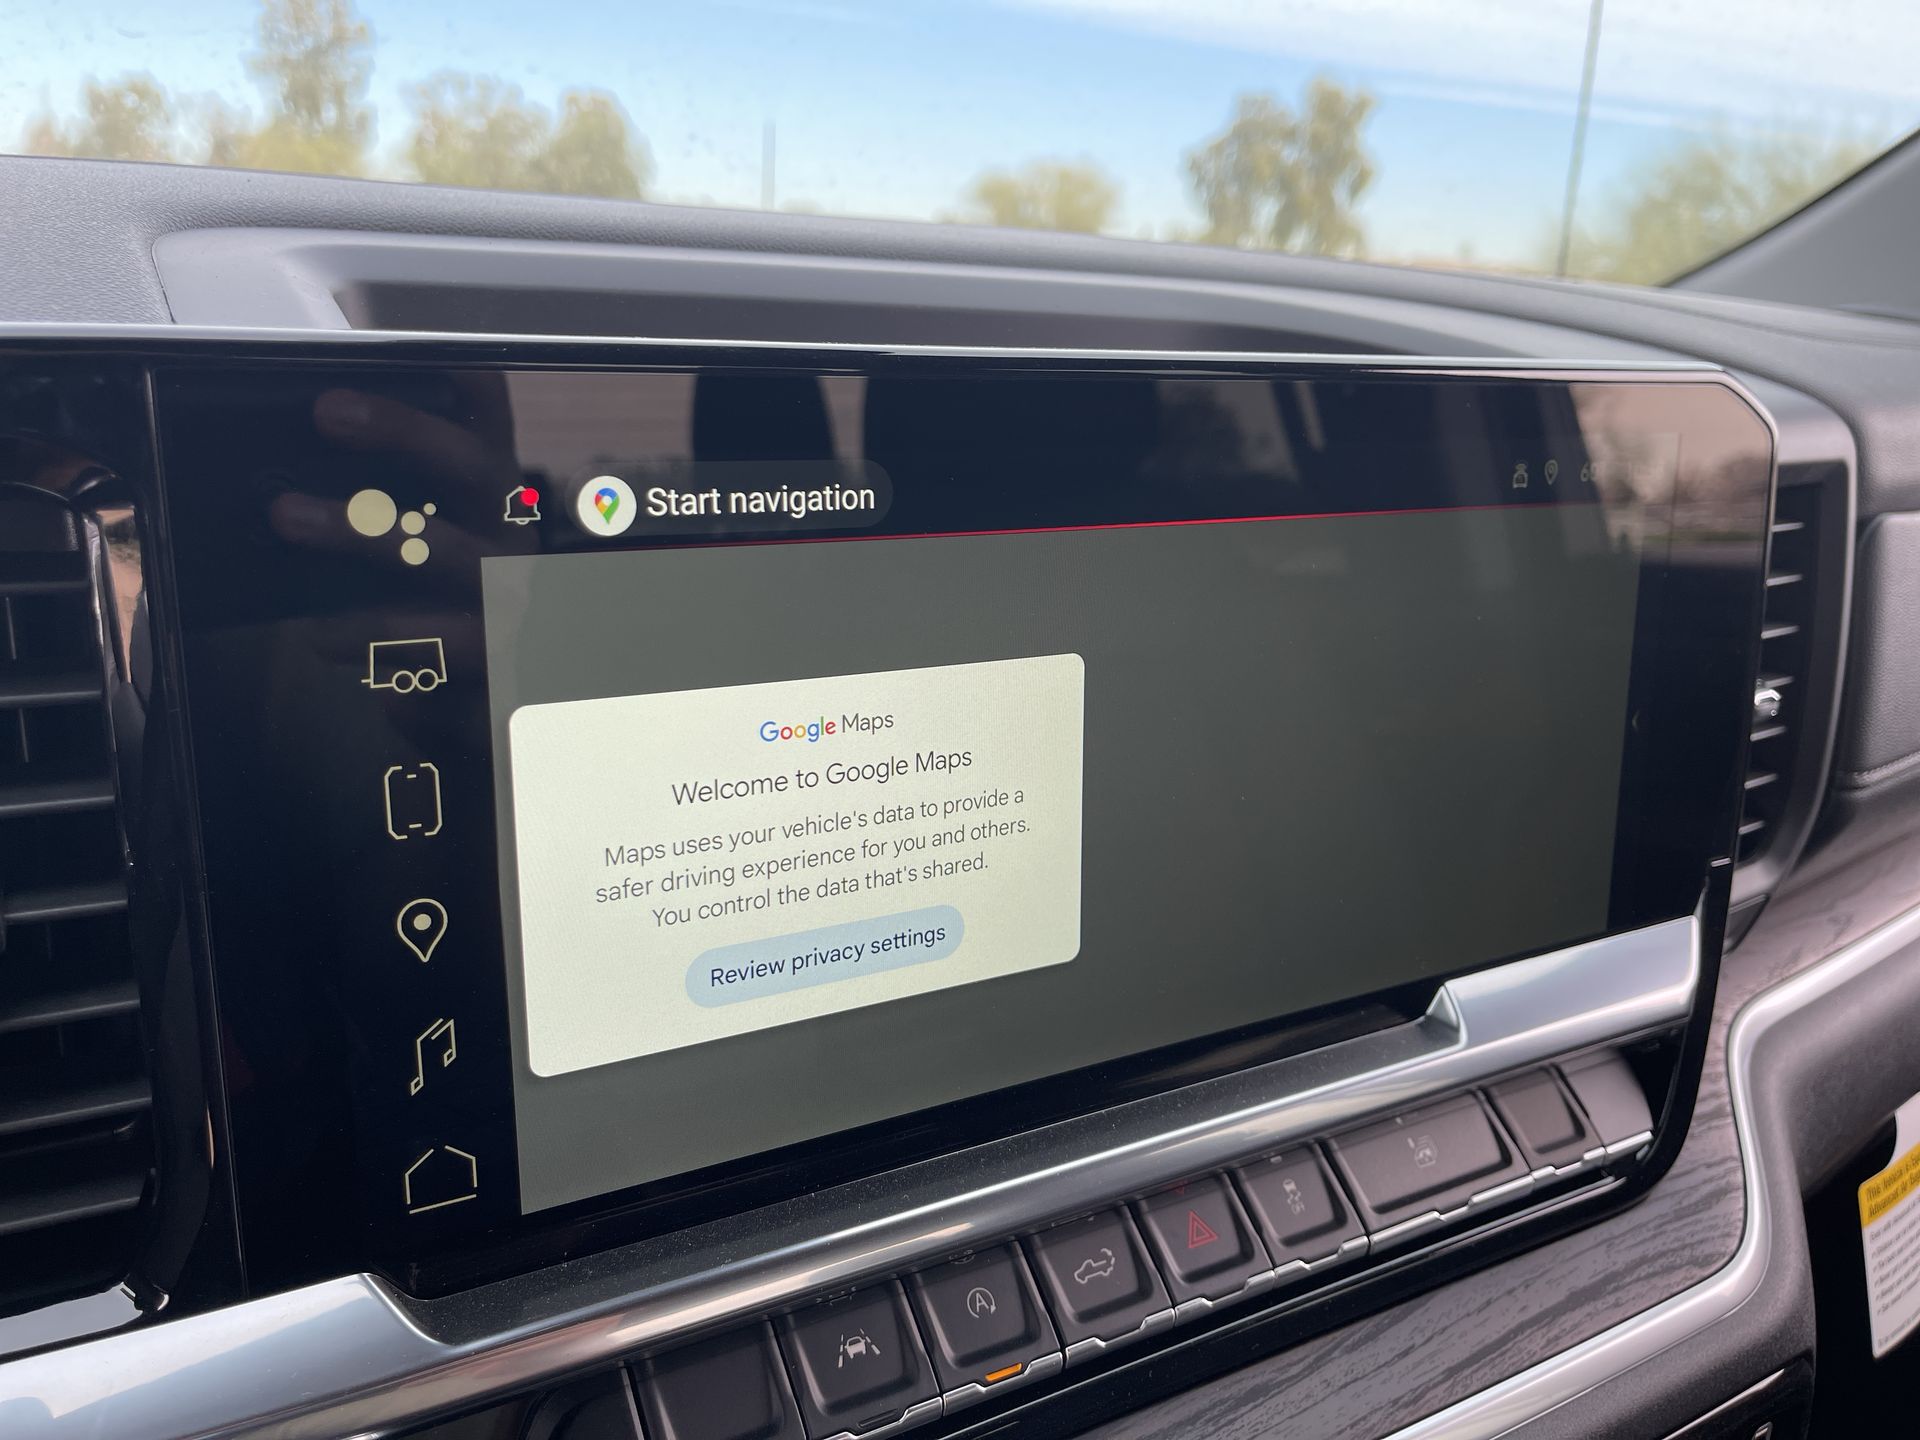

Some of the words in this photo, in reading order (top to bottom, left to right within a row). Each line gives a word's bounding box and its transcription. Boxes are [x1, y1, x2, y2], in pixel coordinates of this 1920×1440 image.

[647, 488, 721, 516] Start
[731, 484, 875, 519] navigation
[759, 717, 837, 742] Google
[842, 711, 894, 734] Maps
[672, 776, 788, 806] Welcome
[796, 769, 819, 788] to
[826, 756, 908, 785] Google
[915, 749, 973, 773] Maps
[605, 842, 665, 868] Maps
[673, 836, 723, 855] uses
[730, 824, 776, 852] your
[783, 810, 868, 839] vehicle's
[873, 802, 915, 824] data
[920, 801, 938, 818] to
[944, 789, 1009, 819] provide
[1014, 789, 1024, 804] a
[596, 880, 654, 903] safer
[661, 864, 735, 894] driving
[742, 848, 855, 878] experience
[862, 839, 887, 860] for
[894, 838, 926, 863] you
[932, 828, 965, 849] and
[970, 817, 1030, 841] others.
[653, 906, 691, 928] You
[698, 888, 772, 920] control
[778, 885, 810, 906] the
[816, 877, 859, 899] data
[865, 866, 918, 889] that's
[923, 853, 989, 880] shared.
[710, 958, 785, 987] Review
[792, 943, 865, 975] privacy
[871, 927, 946, 954] settings
